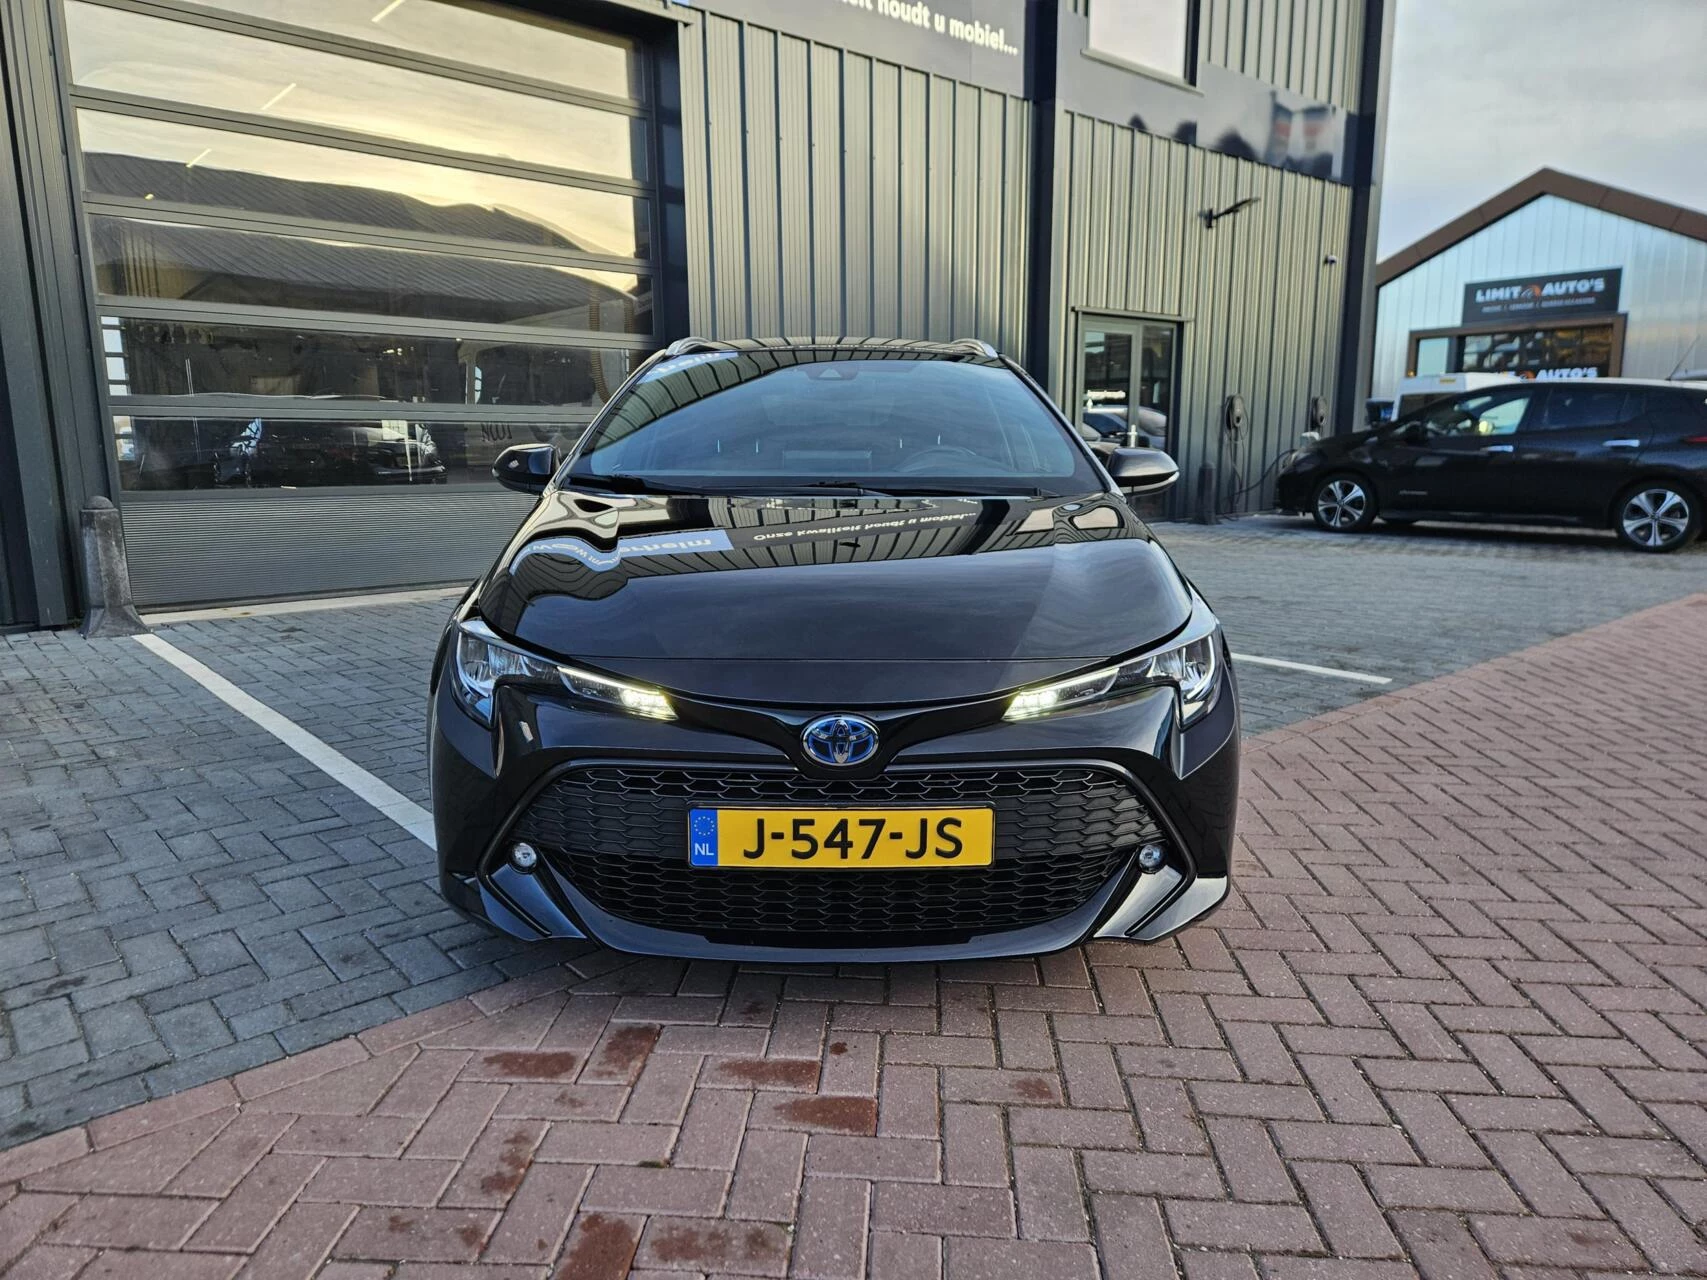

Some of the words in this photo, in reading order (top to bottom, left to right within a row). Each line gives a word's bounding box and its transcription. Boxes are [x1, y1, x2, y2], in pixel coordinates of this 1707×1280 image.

[877, 0, 930, 29] houdt
[934, 13, 946, 33] u
[1476, 286, 1521, 302] LIMIT
[1541, 278, 1604, 296] AUTO'S
[694, 843, 714, 856] NL
[743, 817, 963, 859] J-547-JS
